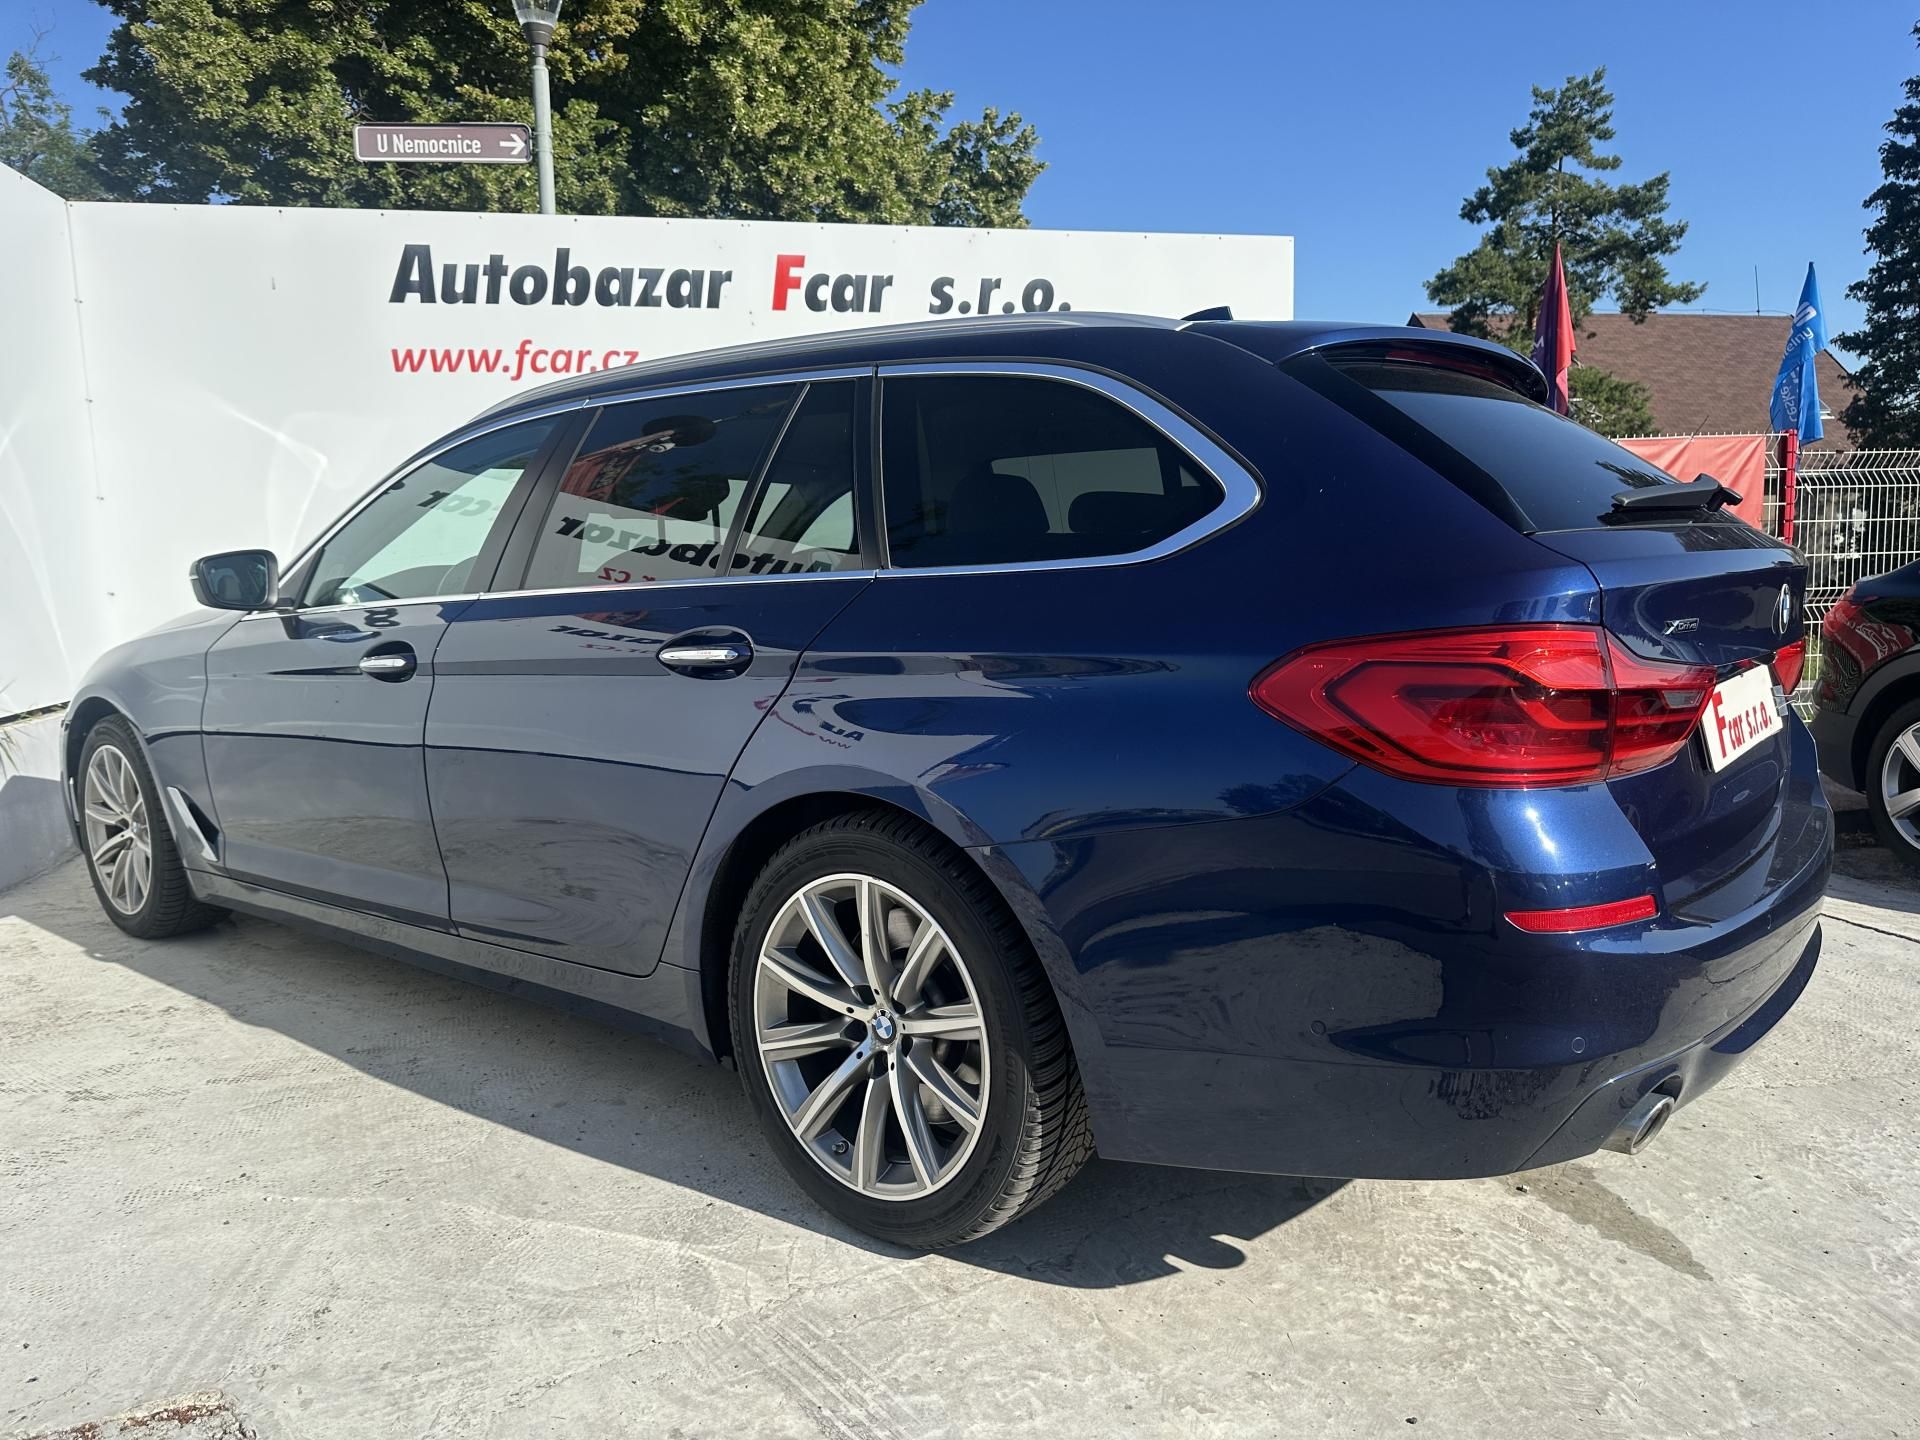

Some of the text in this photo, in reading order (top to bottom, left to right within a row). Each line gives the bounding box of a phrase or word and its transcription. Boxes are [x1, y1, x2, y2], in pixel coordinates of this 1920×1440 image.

[376, 133, 482, 154] U Nemocnice
[388, 243, 1072, 315] Autobazar Fcar s.r.o.
[390, 339, 640, 382] www.fcar.cz
[1711, 690, 1773, 759] Fcar s.r.o.
